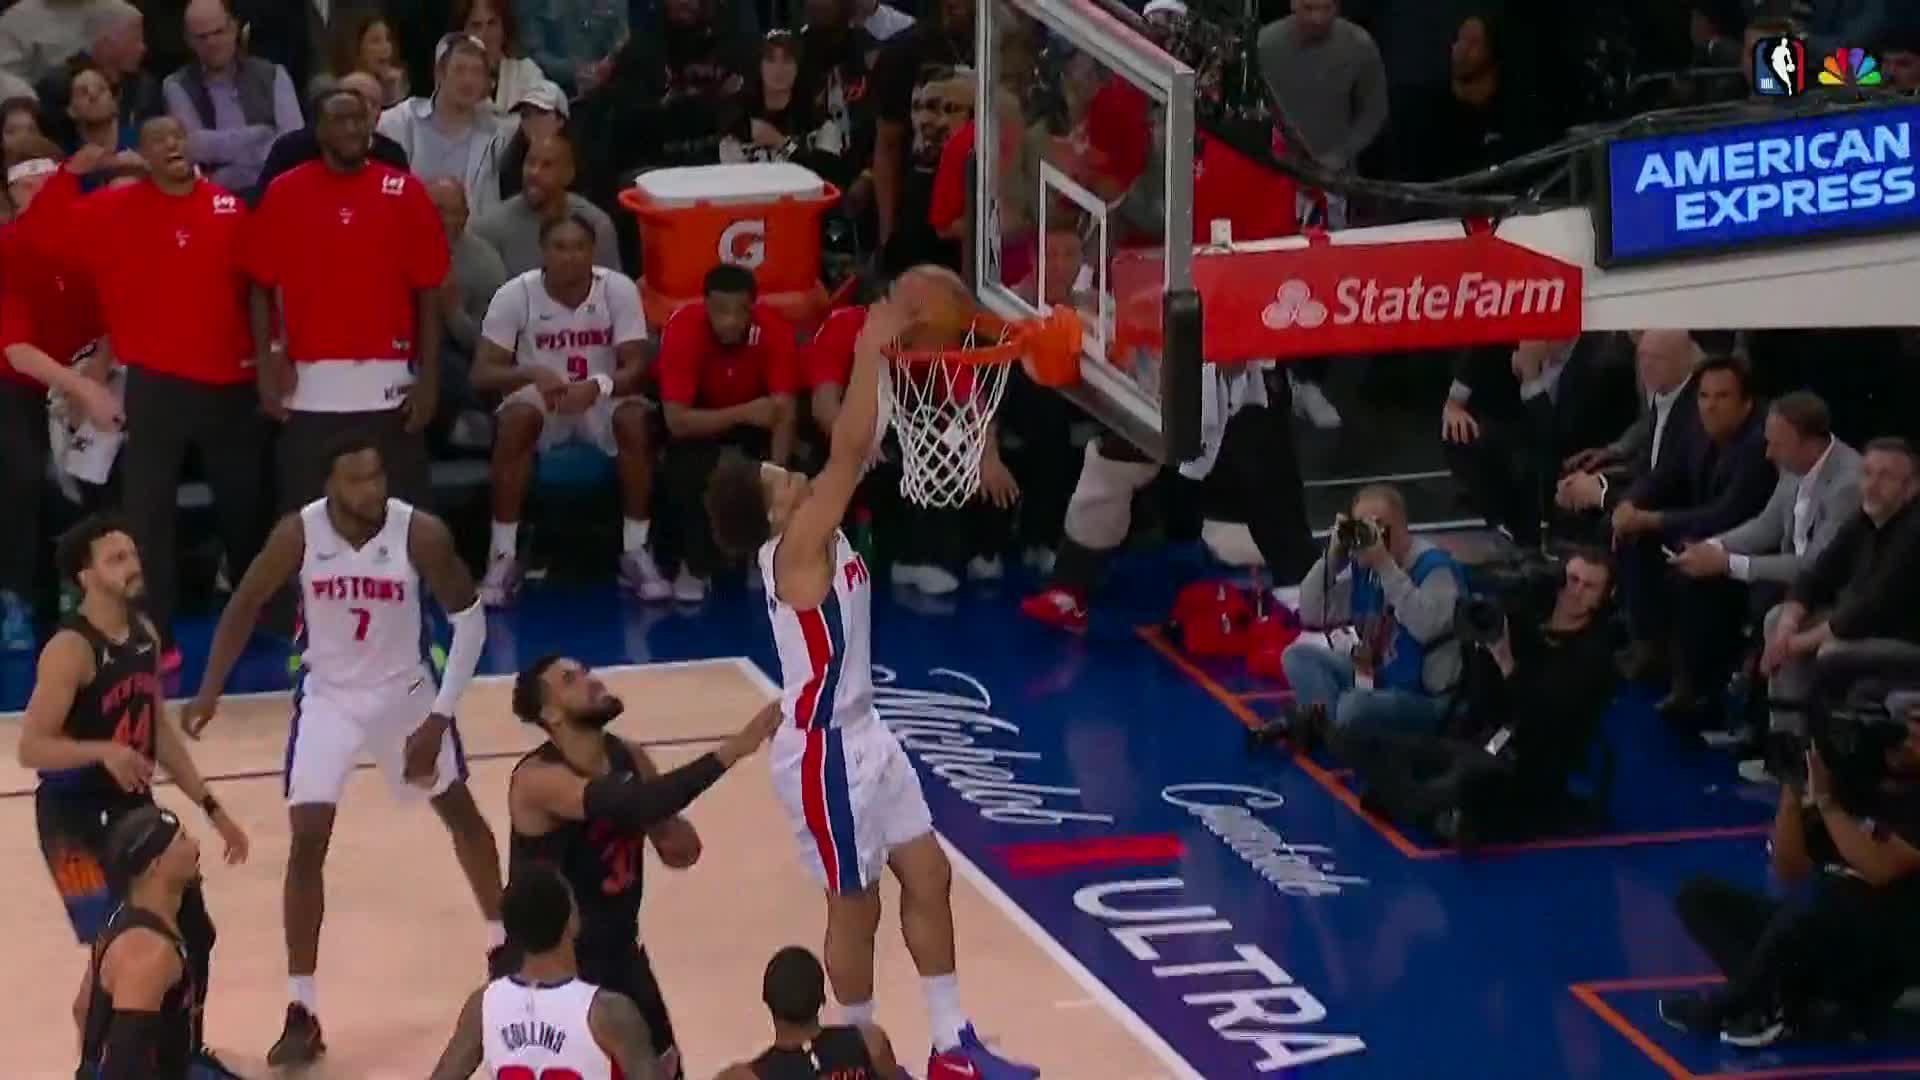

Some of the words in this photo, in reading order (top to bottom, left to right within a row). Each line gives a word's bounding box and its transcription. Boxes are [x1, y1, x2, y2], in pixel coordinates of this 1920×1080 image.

[1635, 122, 1911, 193] AMERICAN
[1675, 165, 1916, 231] EXPRESS
[717, 219, 765, 269] G
[535, 328, 614, 351] PISTONS
[566, 356, 588, 381] 9
[311, 575, 405, 602] PISTONS
[349, 607, 371, 641] 7
[1073, 877, 1367, 1073] ULTRA
